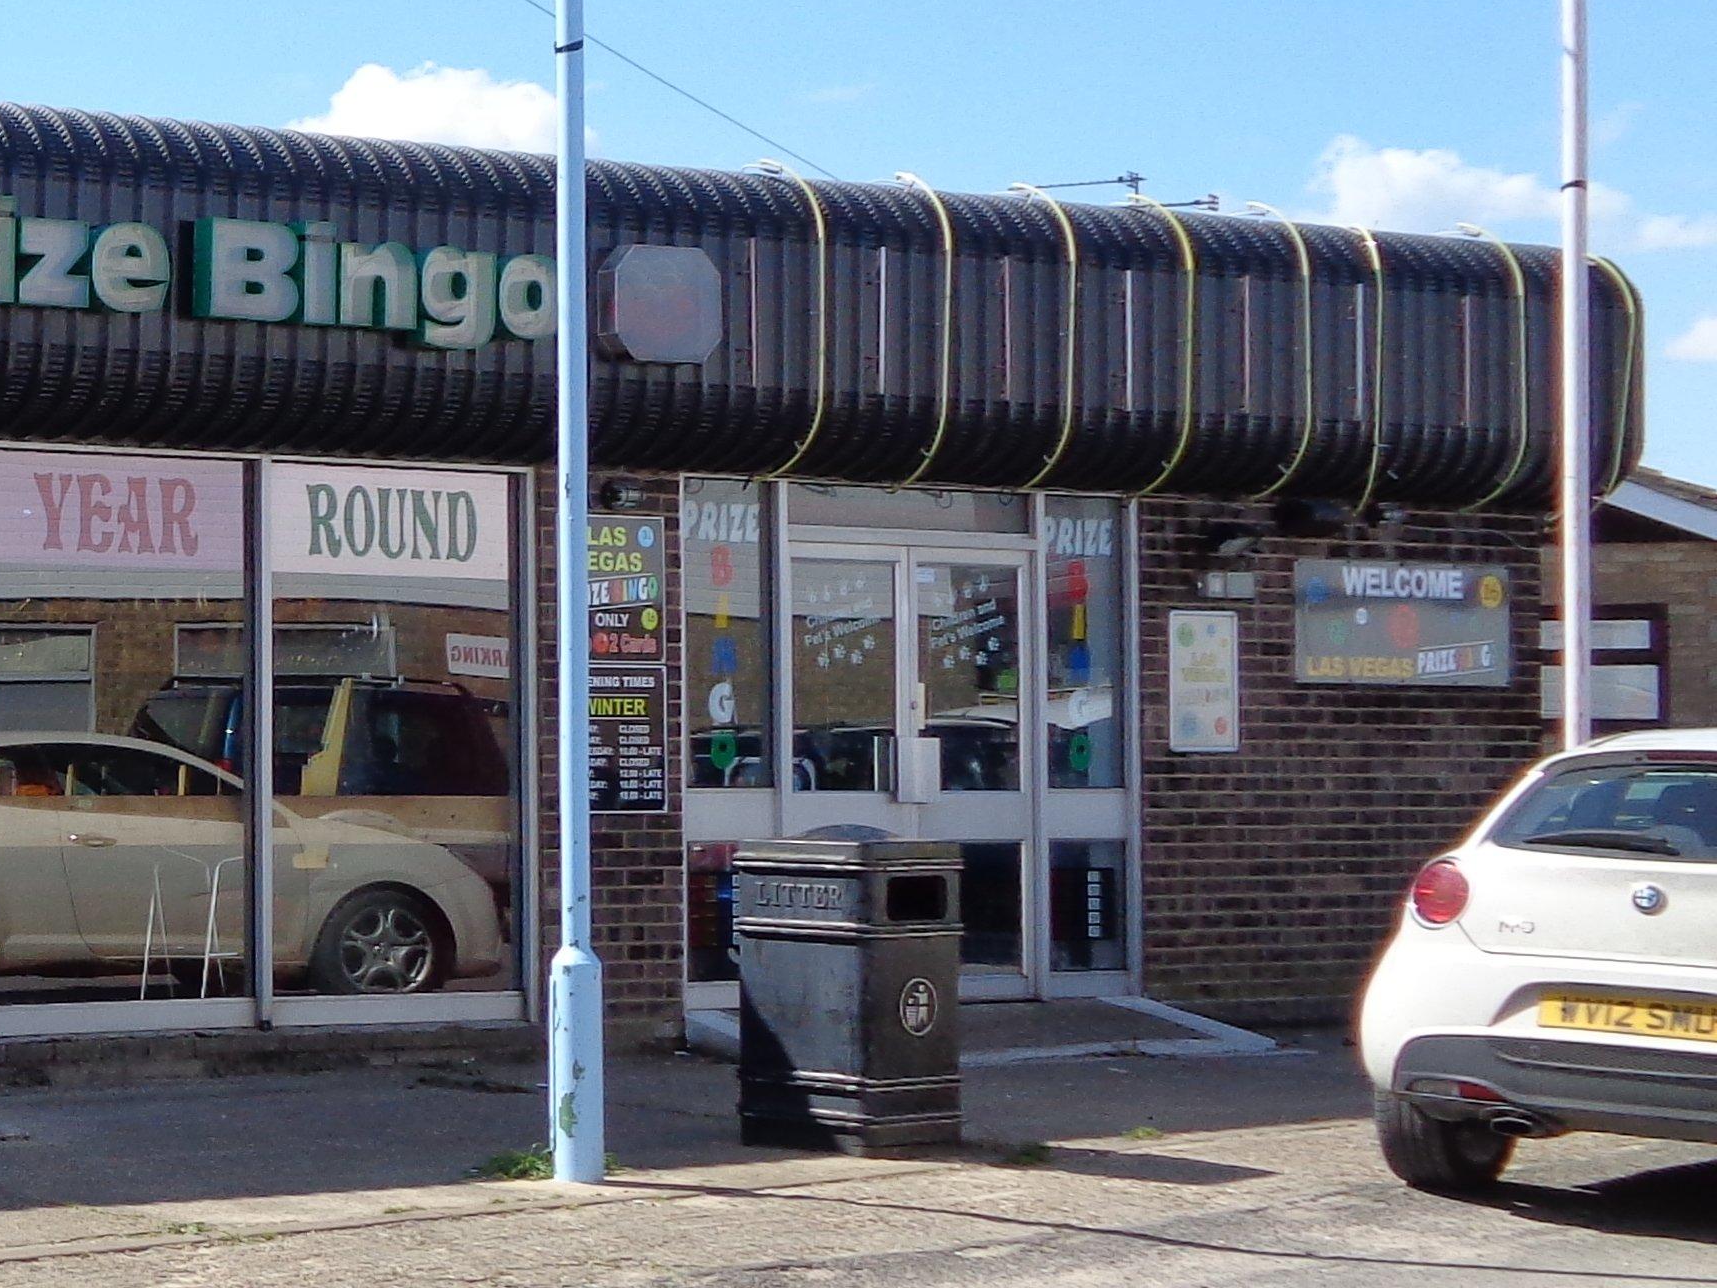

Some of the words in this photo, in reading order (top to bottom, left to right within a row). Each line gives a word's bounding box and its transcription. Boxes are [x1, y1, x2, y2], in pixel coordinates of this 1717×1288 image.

[193, 216, 558, 351] Bingo
[33, 472, 199, 556] YEAR
[306, 483, 478, 563] ROUND
[683, 500, 760, 543] PRIZE
[1043, 516, 1114, 557] PRIZE
[588, 551, 643, 573] EGAS
[1342, 565, 1464, 600] WELCOME
[594, 612, 630, 627] ONLY
[588, 676, 620, 688] ENING
[622, 676, 655, 688] TIMES
[754, 881, 844, 910] LITTER
